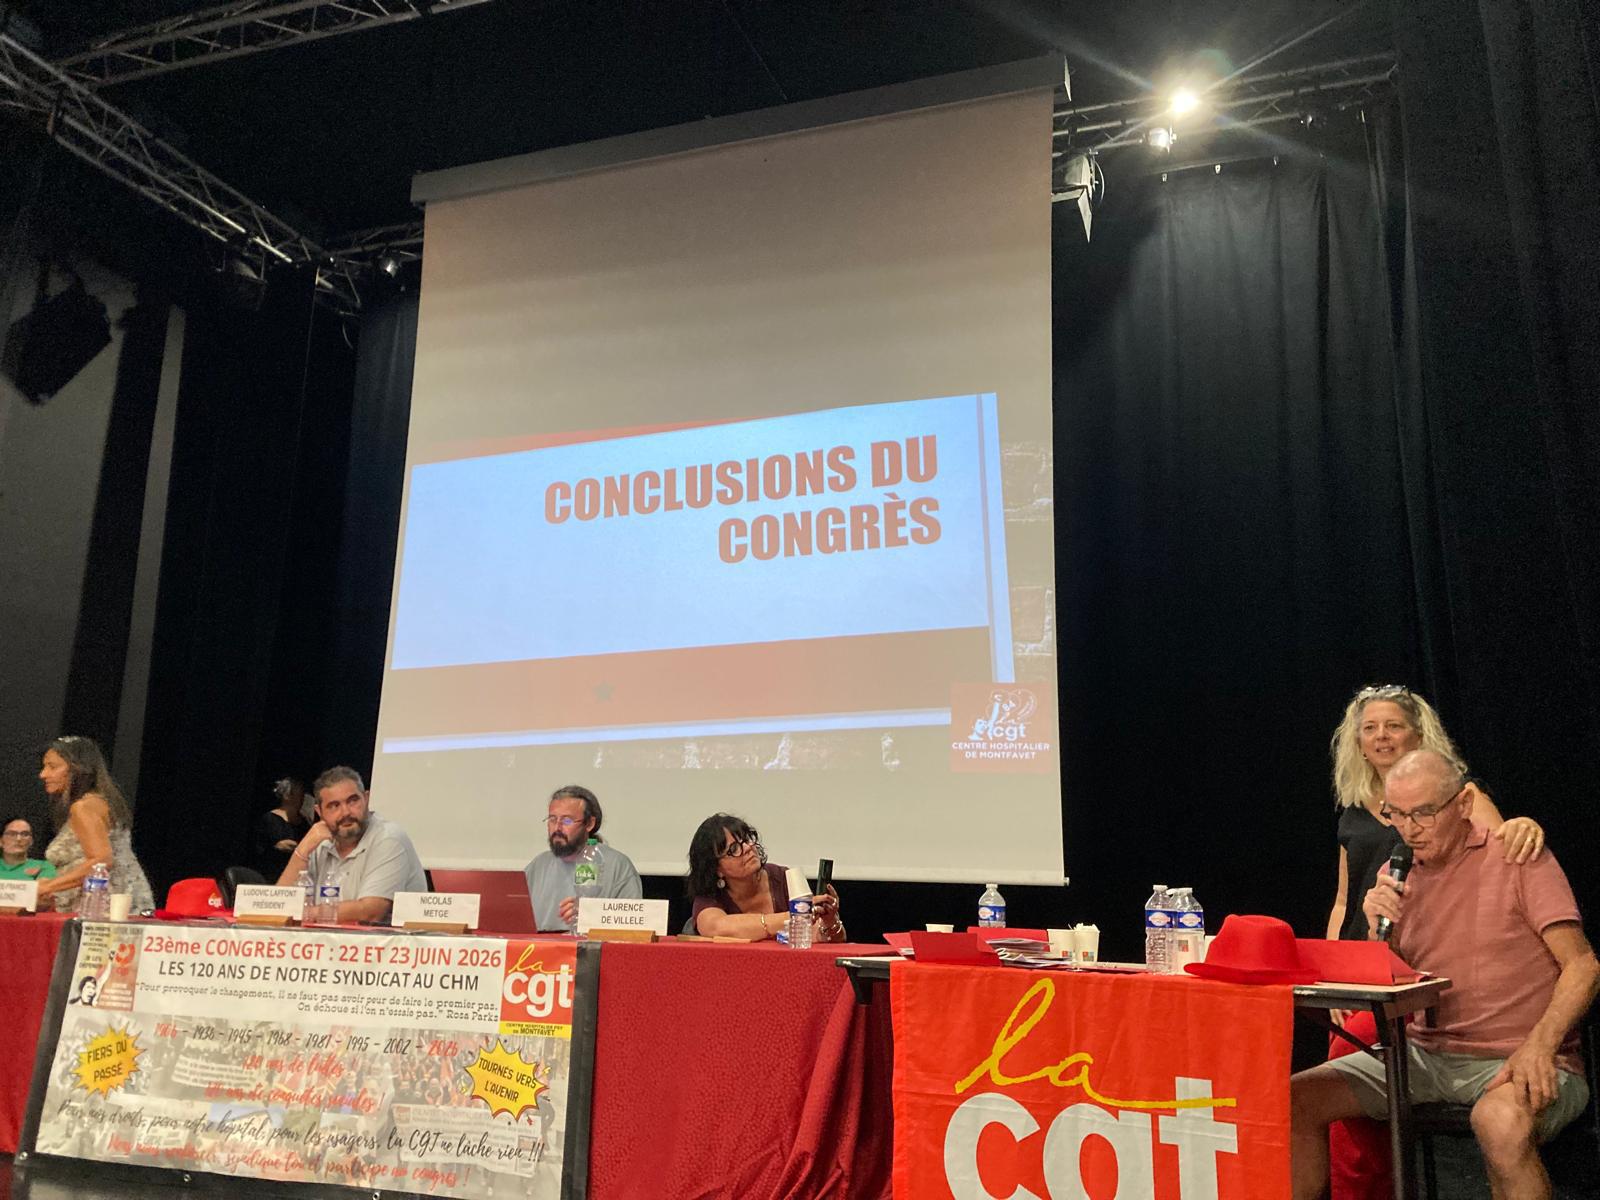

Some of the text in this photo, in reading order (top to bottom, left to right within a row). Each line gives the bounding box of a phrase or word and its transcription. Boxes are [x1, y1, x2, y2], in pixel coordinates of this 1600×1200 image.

[544, 435, 938, 524] CONCLUSIONS DU
[718, 493, 942, 564] CONGRÈS
[992, 722, 1026, 741] cgt
[952, 742, 1050, 751] CENTRE HOSPITALIER
[965, 751, 1037, 760] DE MONTFAVET
[243, 889, 269, 897] LUDOVIC
[419, 896, 453, 905] NICOLAS
[252, 900, 286, 910] PRÉSIDENT
[423, 909, 449, 918] METGE
[602, 902, 644, 912] LAURENCE
[601, 916, 645, 925] DE VILLELE
[143, 935, 200, 955] 23ème
[205, 937, 287, 958] CONGRÈS
[291, 943, 324, 960] CGT
[338, 945, 359, 963] 22
[364, 946, 385, 963] ET
[389, 946, 410, 965] 23
[411, 947, 452, 968] JUIN
[457, 948, 502, 968] 2026
[507, 943, 573, 974] la
[158, 960, 479, 991] LES 120 ANS DE NOTRE SYNDICAT AU CHM
[162, 984, 208, 997] provoquer
[299, 989, 318, 1001] faut
[320, 993, 339, 1005] pas
[340, 992, 365, 1004] avoir
[365, 995, 386, 1008] peur
[388, 994, 401, 1005] de
[401, 994, 423, 1007] faire
[435, 999, 476, 1012] premier
[503, 964, 574, 1018] cgt
[297, 1002, 310, 1012] On
[313, 1001, 350, 1014] échoue
[445, 1010, 470, 1021] Rosa
[470, 1011, 499, 1023] Parks
[192, 1025, 216, 1041] 1936
[228, 1028, 252, 1045] 1945
[267, 1030, 294, 1046] 1968
[345, 1034, 370, 1051] 1995
[383, 1037, 412, 1056] 2002
[428, 1039, 458, 1057] 2026
[520, 1027, 556, 1036] MONTFAVET
[87, 1039, 127, 1064] FIERS DU
[955, 977, 1237, 1109] la
[484, 1080, 520, 1103] L'AVENIR
[516, 1074, 537, 1088] VERS
[303, 1121, 322, 1146] les
[387, 1126, 404, 1151] la
[408, 1128, 442, 1157] CGT
[441, 1139, 453, 1153] ne
[456, 1131, 493, 1158] lâche
[498, 1144, 524, 1160] rien
